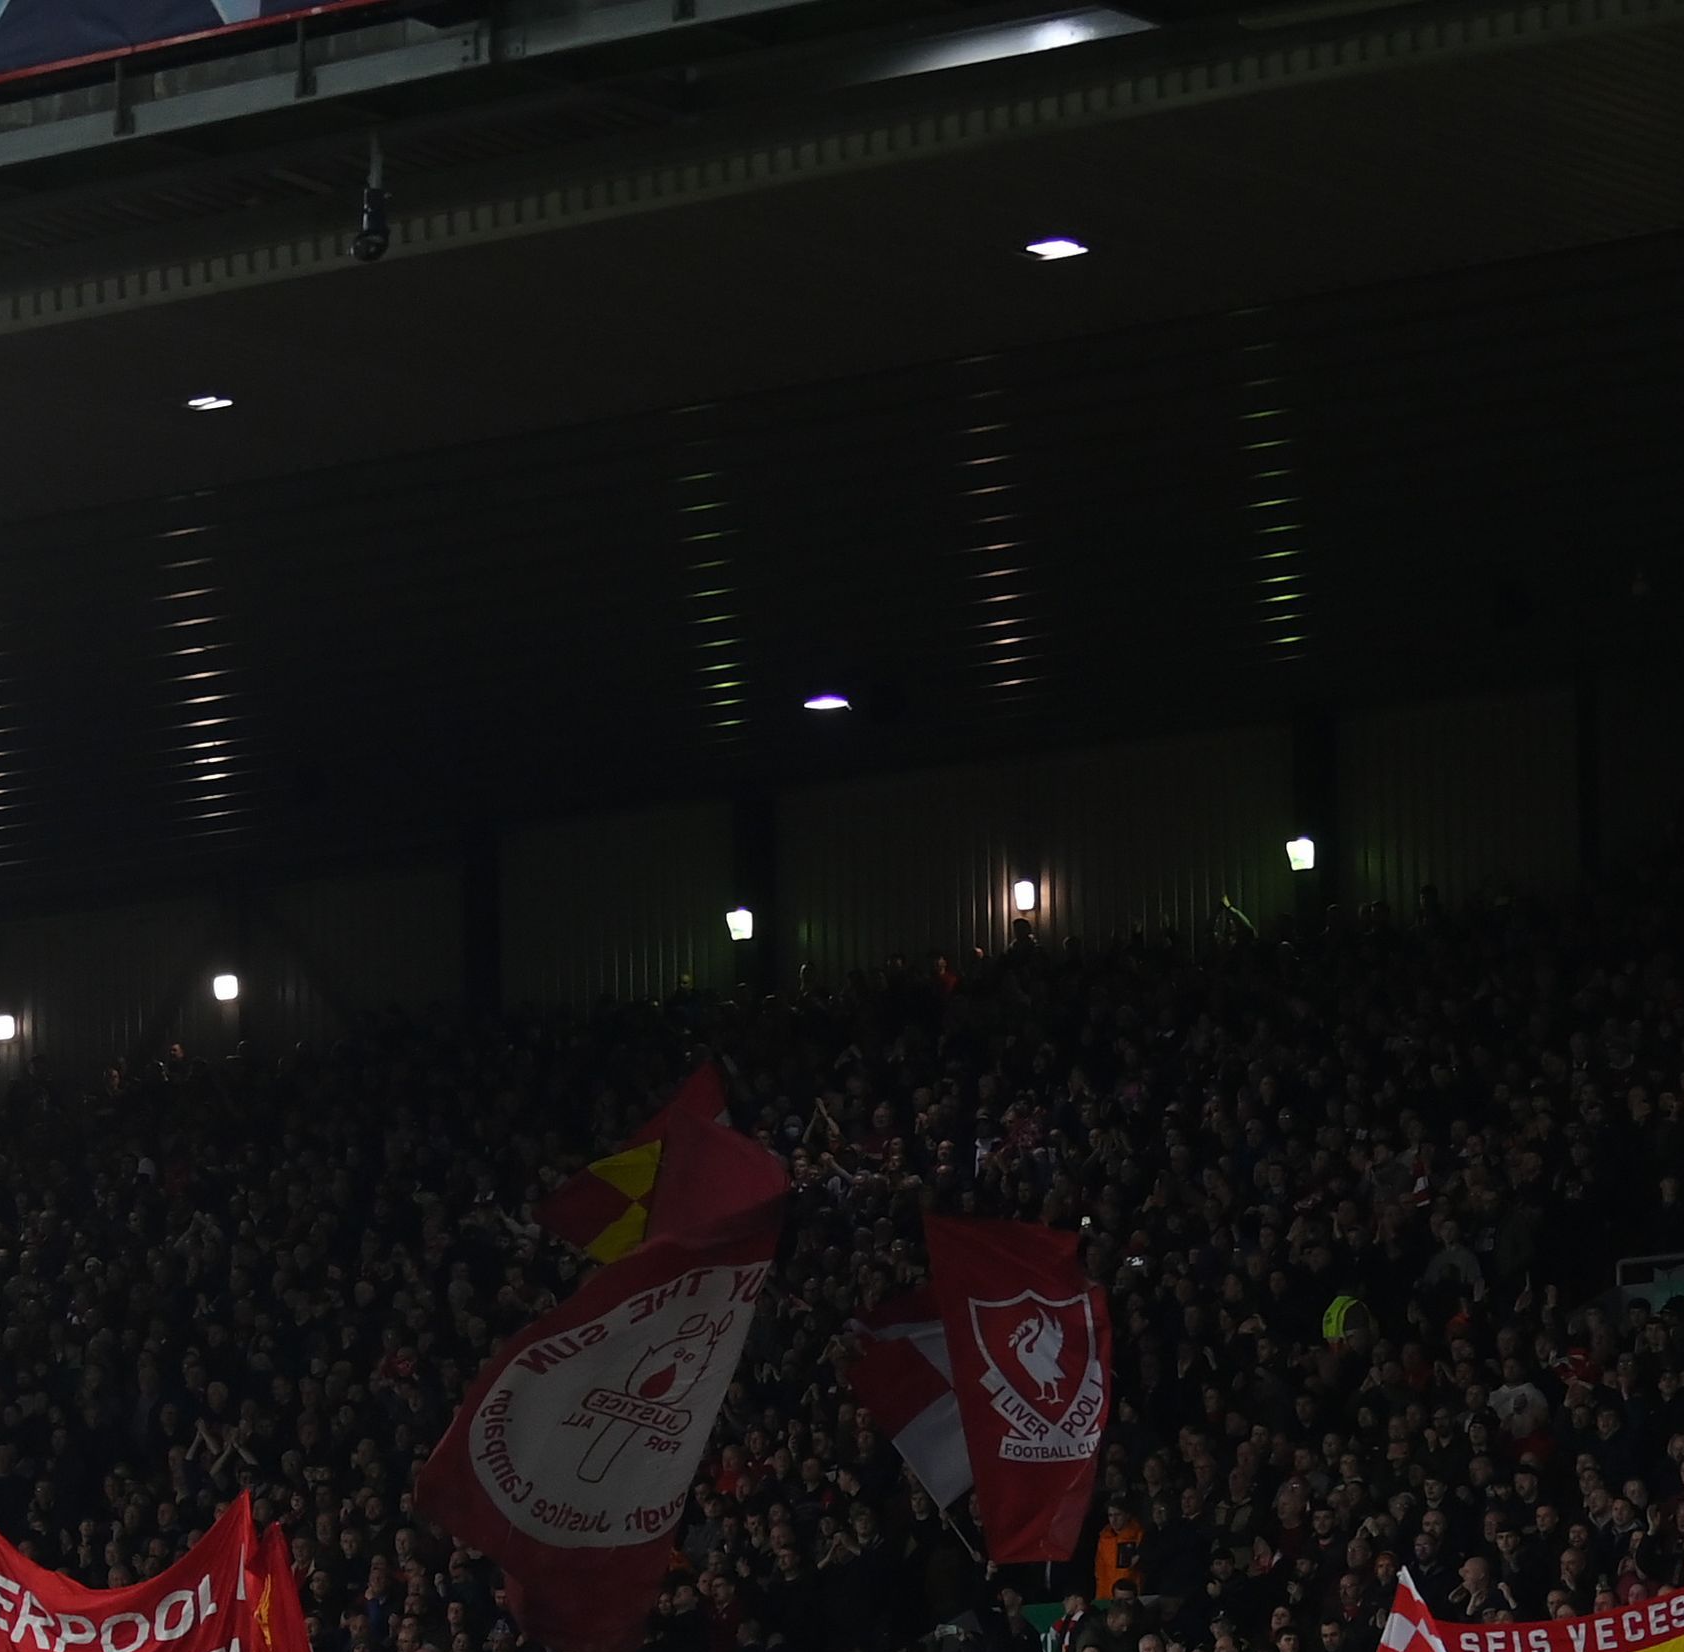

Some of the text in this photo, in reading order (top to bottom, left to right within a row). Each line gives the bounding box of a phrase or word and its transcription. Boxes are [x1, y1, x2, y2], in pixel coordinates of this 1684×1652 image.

[1000, 1394, 1102, 1441] LIVER POOL
[1004, 1442, 1075, 1459] FOOTBALL
